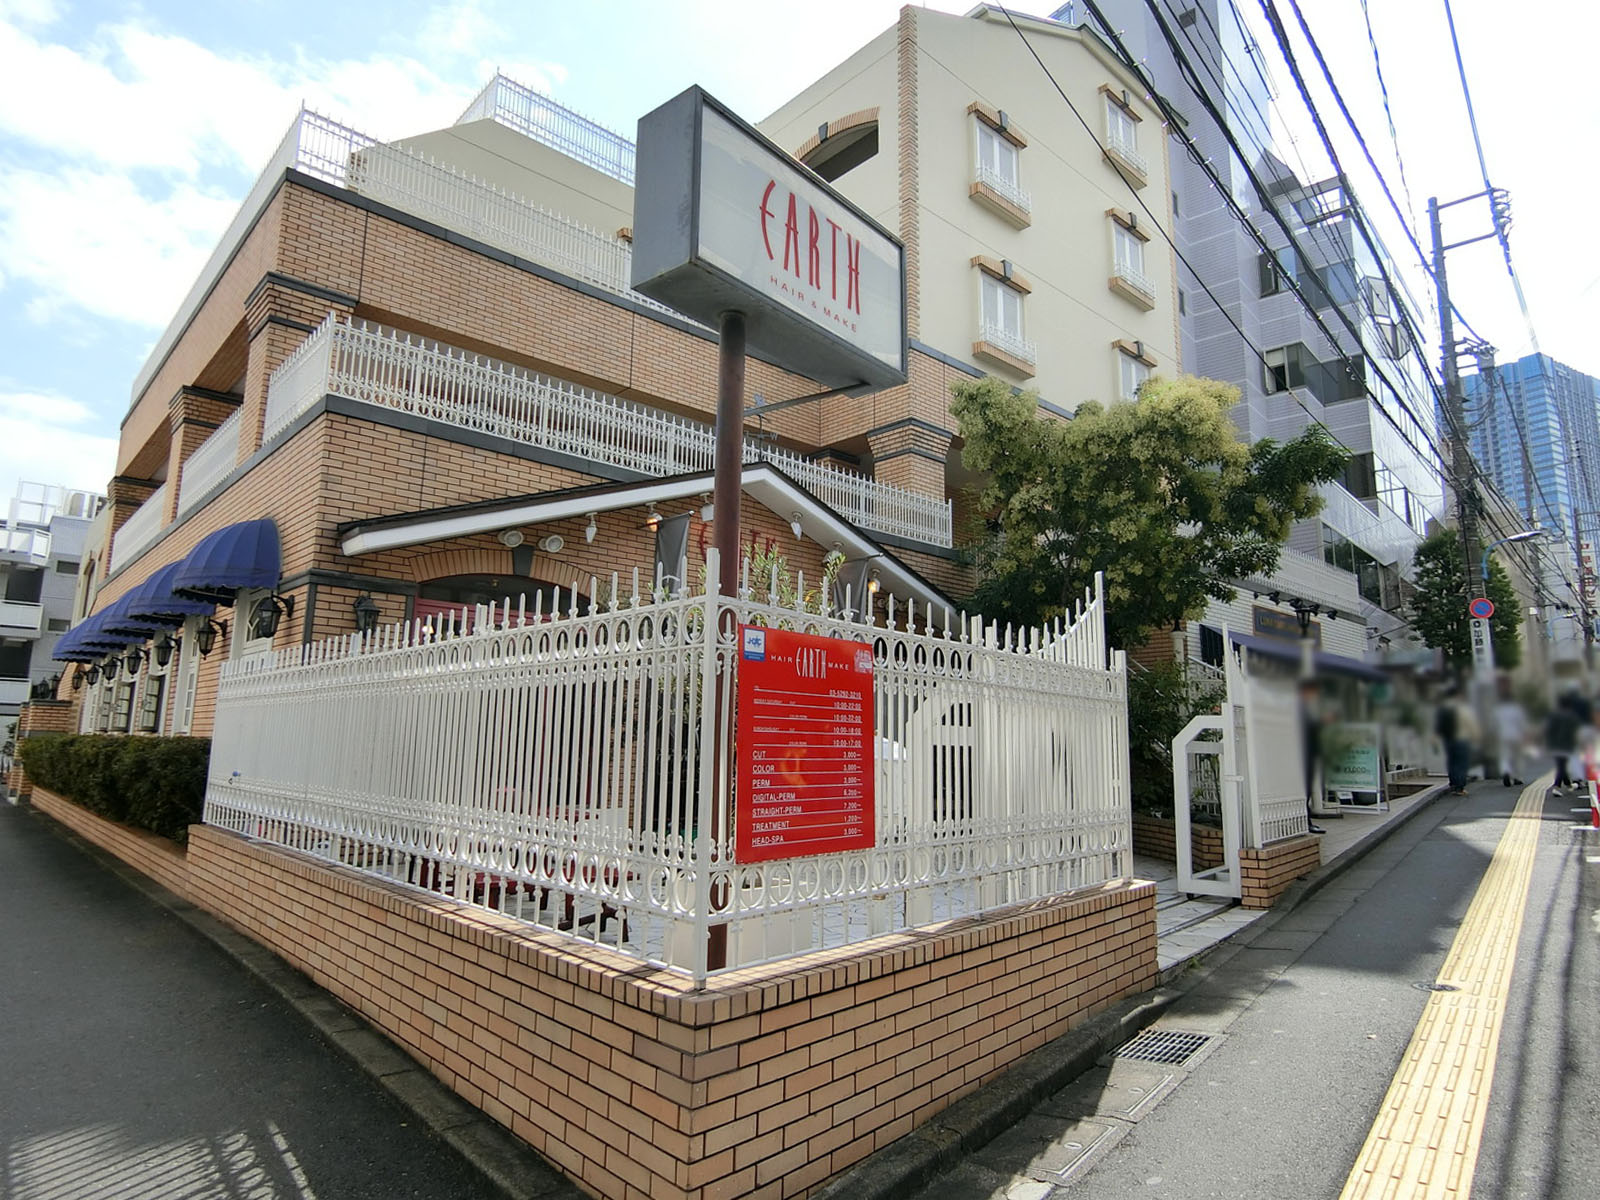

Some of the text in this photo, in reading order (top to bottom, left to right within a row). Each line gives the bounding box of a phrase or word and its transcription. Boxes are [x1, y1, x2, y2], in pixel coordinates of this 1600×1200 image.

[759, 179, 861, 315] EARTH
[770, 275, 805, 302] HAIR
[823, 307, 857, 333] MAKE
[771, 655, 793, 663] HAIR
[795, 647, 827, 679] EARTH
[828, 662, 849, 671] MAKE
[752, 750, 766, 758] CUT
[752, 764, 775, 773] COLOR
[752, 779, 770, 787] PERM
[752, 821, 790, 831] TREATMENT
